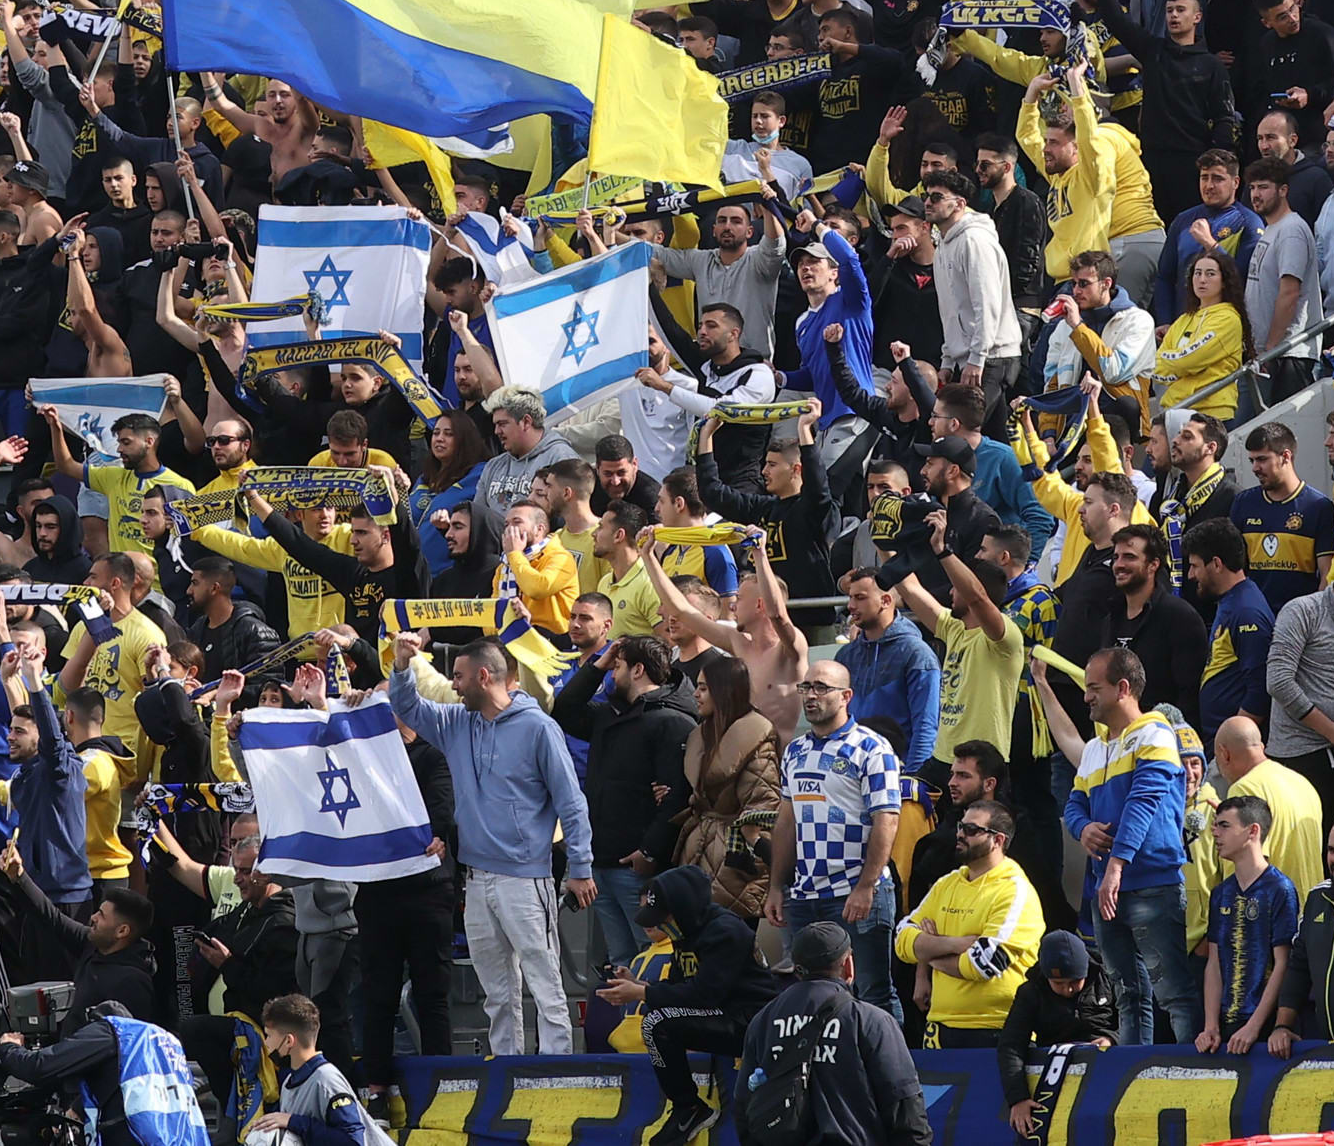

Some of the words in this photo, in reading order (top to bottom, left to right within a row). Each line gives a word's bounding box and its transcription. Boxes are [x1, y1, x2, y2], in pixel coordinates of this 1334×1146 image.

[275, 342, 336, 366] MACCABI
[336, 341, 360, 362] TEL
[1246, 517, 1262, 526] FILA
[1238, 624, 1258, 633] FILA
[797, 780, 822, 794] VISA
[331, 1097, 352, 1110] FILA
